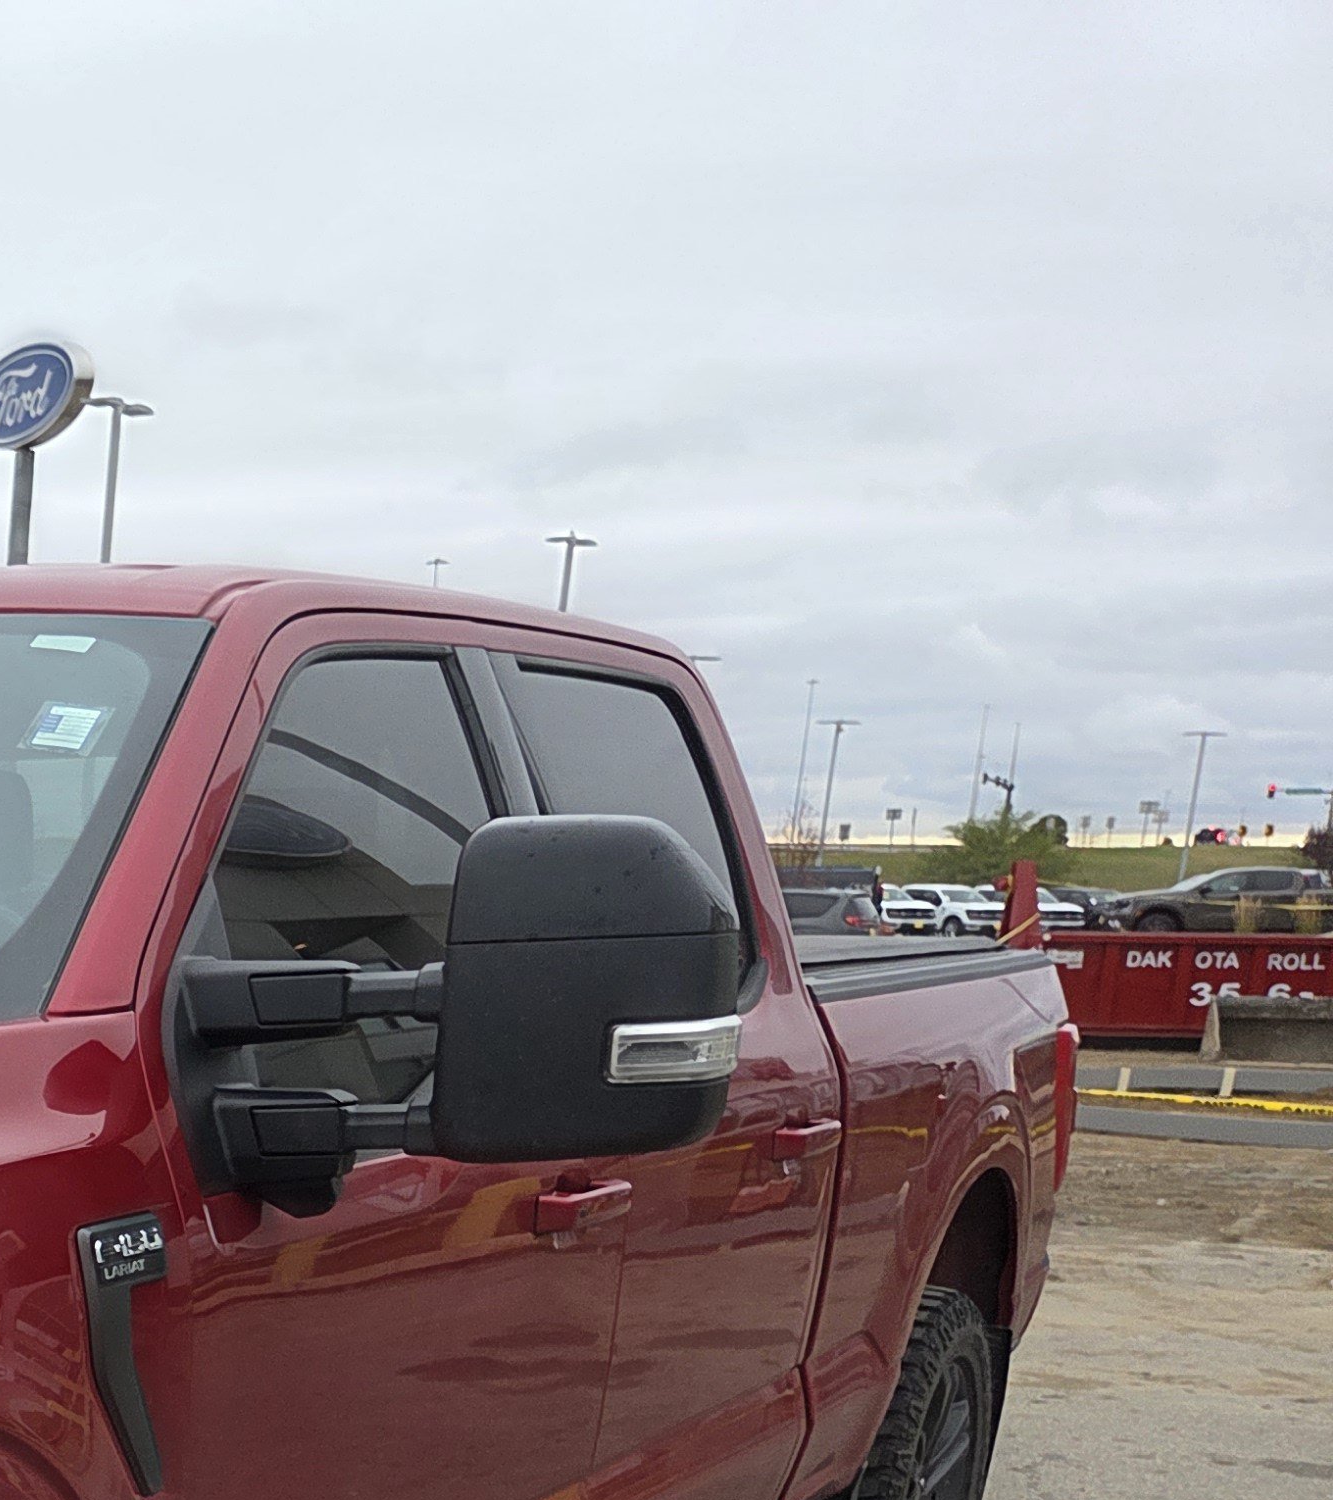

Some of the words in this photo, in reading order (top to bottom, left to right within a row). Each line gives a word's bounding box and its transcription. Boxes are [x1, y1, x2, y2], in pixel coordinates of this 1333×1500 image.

[1126, 951, 1173, 968] DAK
[1195, 951, 1240, 970] OTA
[1267, 952, 1326, 971] ROLL
[104, 1259, 146, 1280] LARIAT
